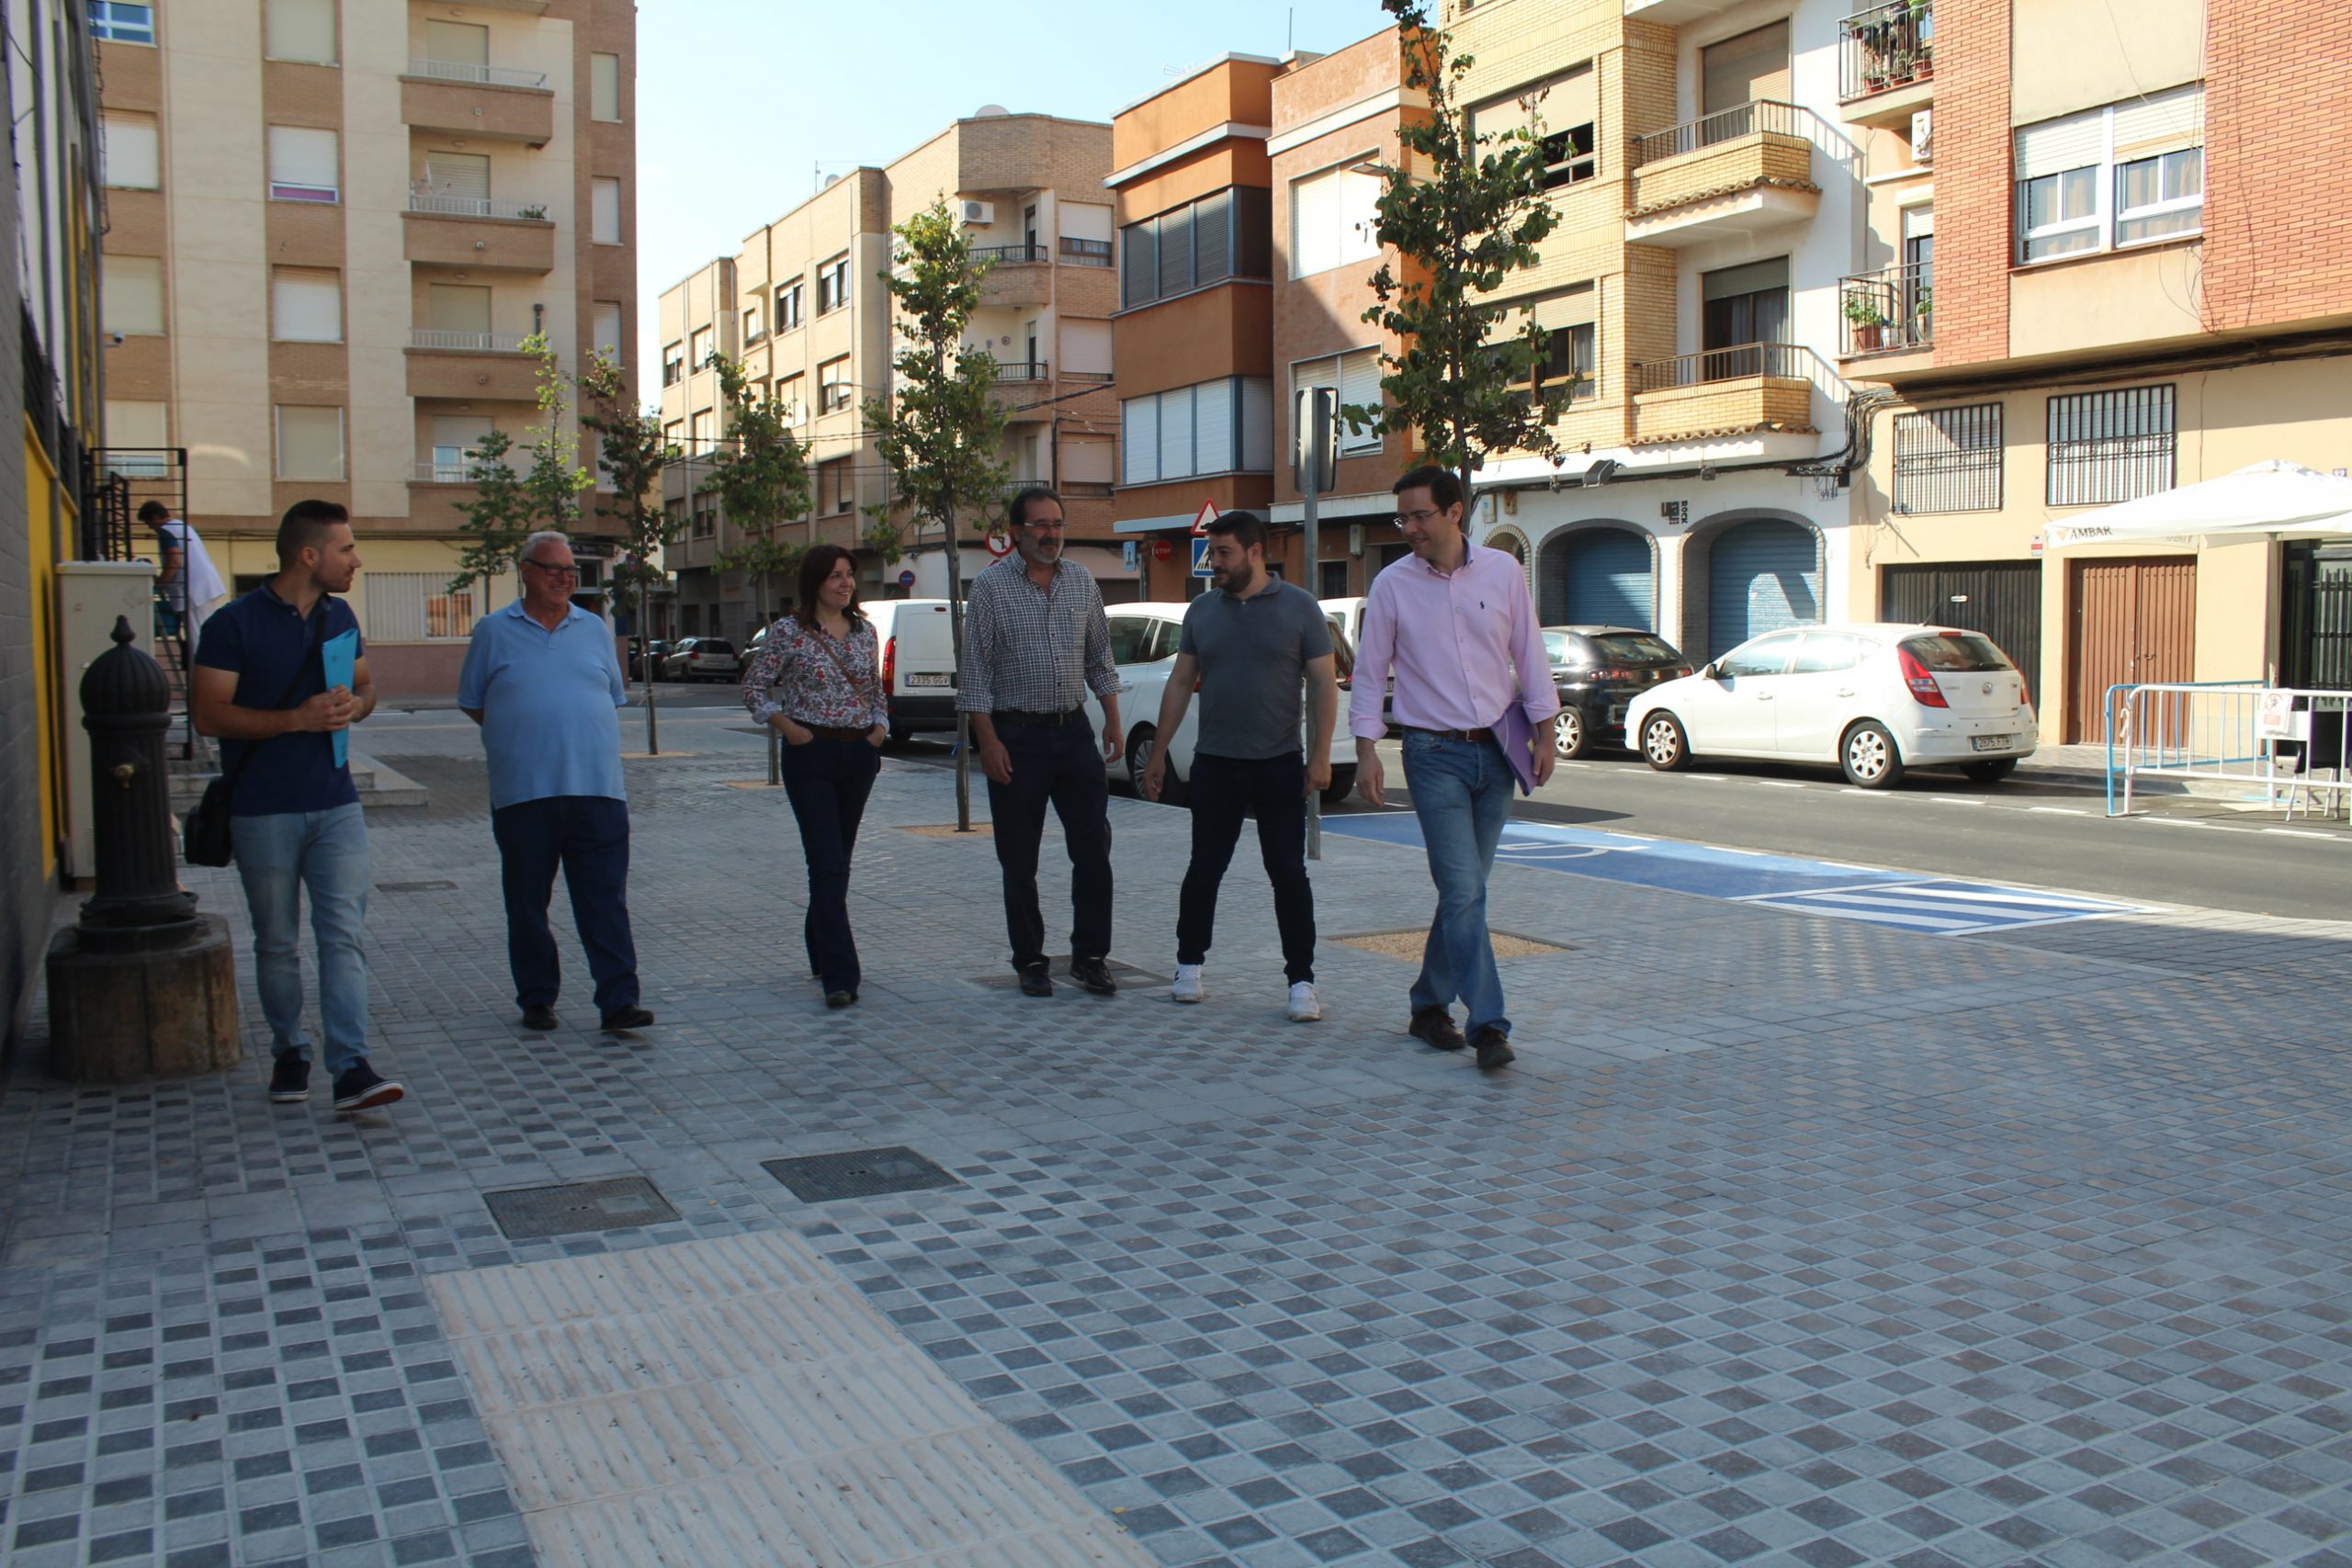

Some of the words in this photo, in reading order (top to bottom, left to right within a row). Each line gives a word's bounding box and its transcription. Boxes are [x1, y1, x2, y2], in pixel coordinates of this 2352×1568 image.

[2070, 525, 2113, 540] AMBAR
[910, 676, 931, 684] 2335
[933, 676, 948, 684] GGV
